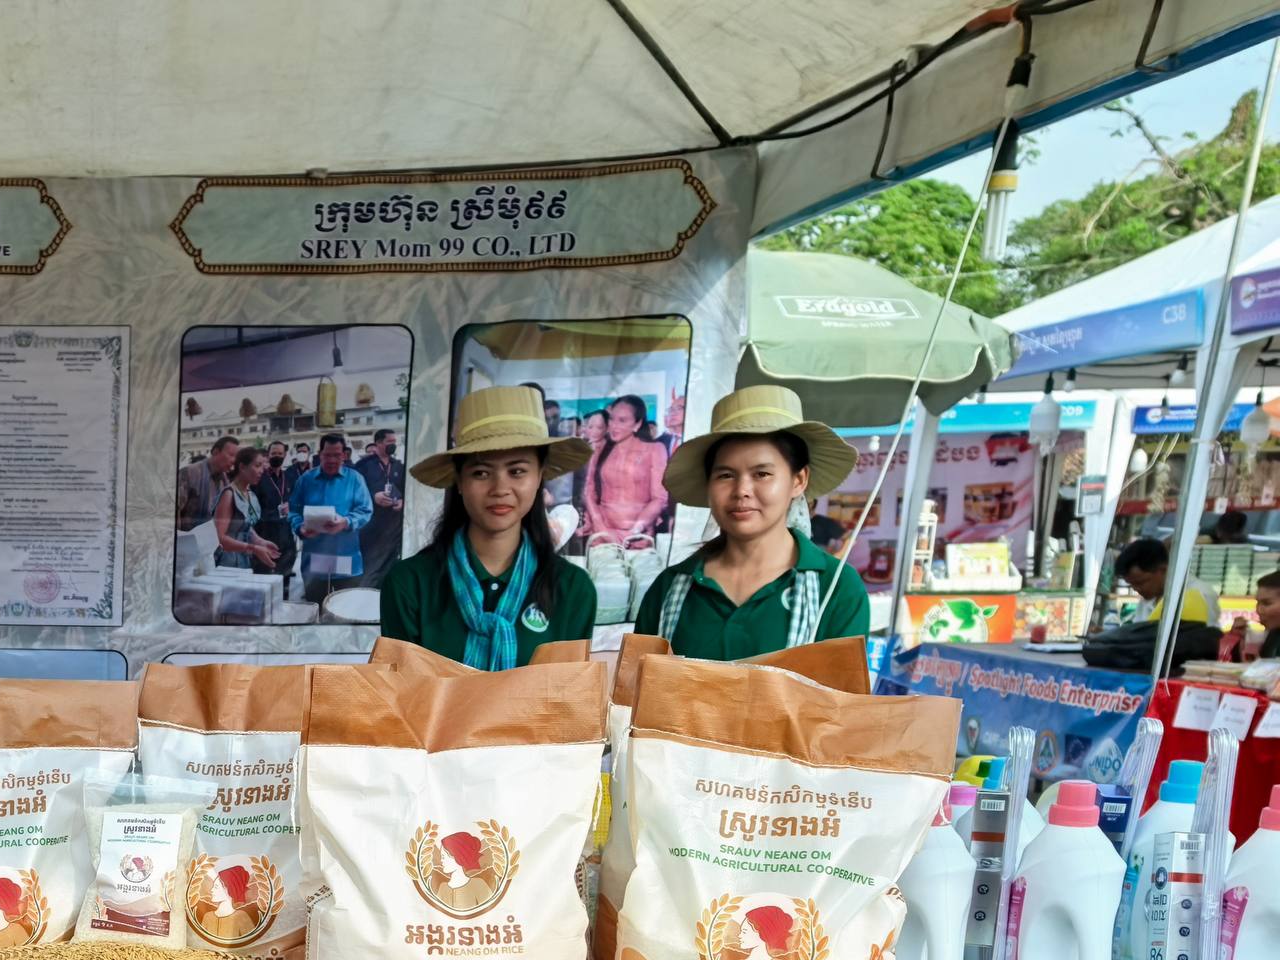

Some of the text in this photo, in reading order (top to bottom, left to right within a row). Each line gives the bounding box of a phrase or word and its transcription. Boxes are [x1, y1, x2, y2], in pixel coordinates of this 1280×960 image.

[300, 238, 368, 260] SREY
[374, 238, 431, 258] Mom
[439, 237, 465, 257] 99
[528, 232, 576, 256] LTD
[969, 664, 1022, 697] Spotlight
[1022, 672, 1058, 699] Foods
[202, 813, 281, 826] SRAUV NEANG OM
[27, 825, 43, 834] OM
[196, 823, 301, 837] AGRICULTURAL COOPER
[720, 844, 831, 861] SRAUV NEANG OM
[713, 857, 802, 873] AGRICULTURAL
[807, 863, 875, 886] COOPERATIVE
[446, 946, 524, 956] NEANG OM RICE
